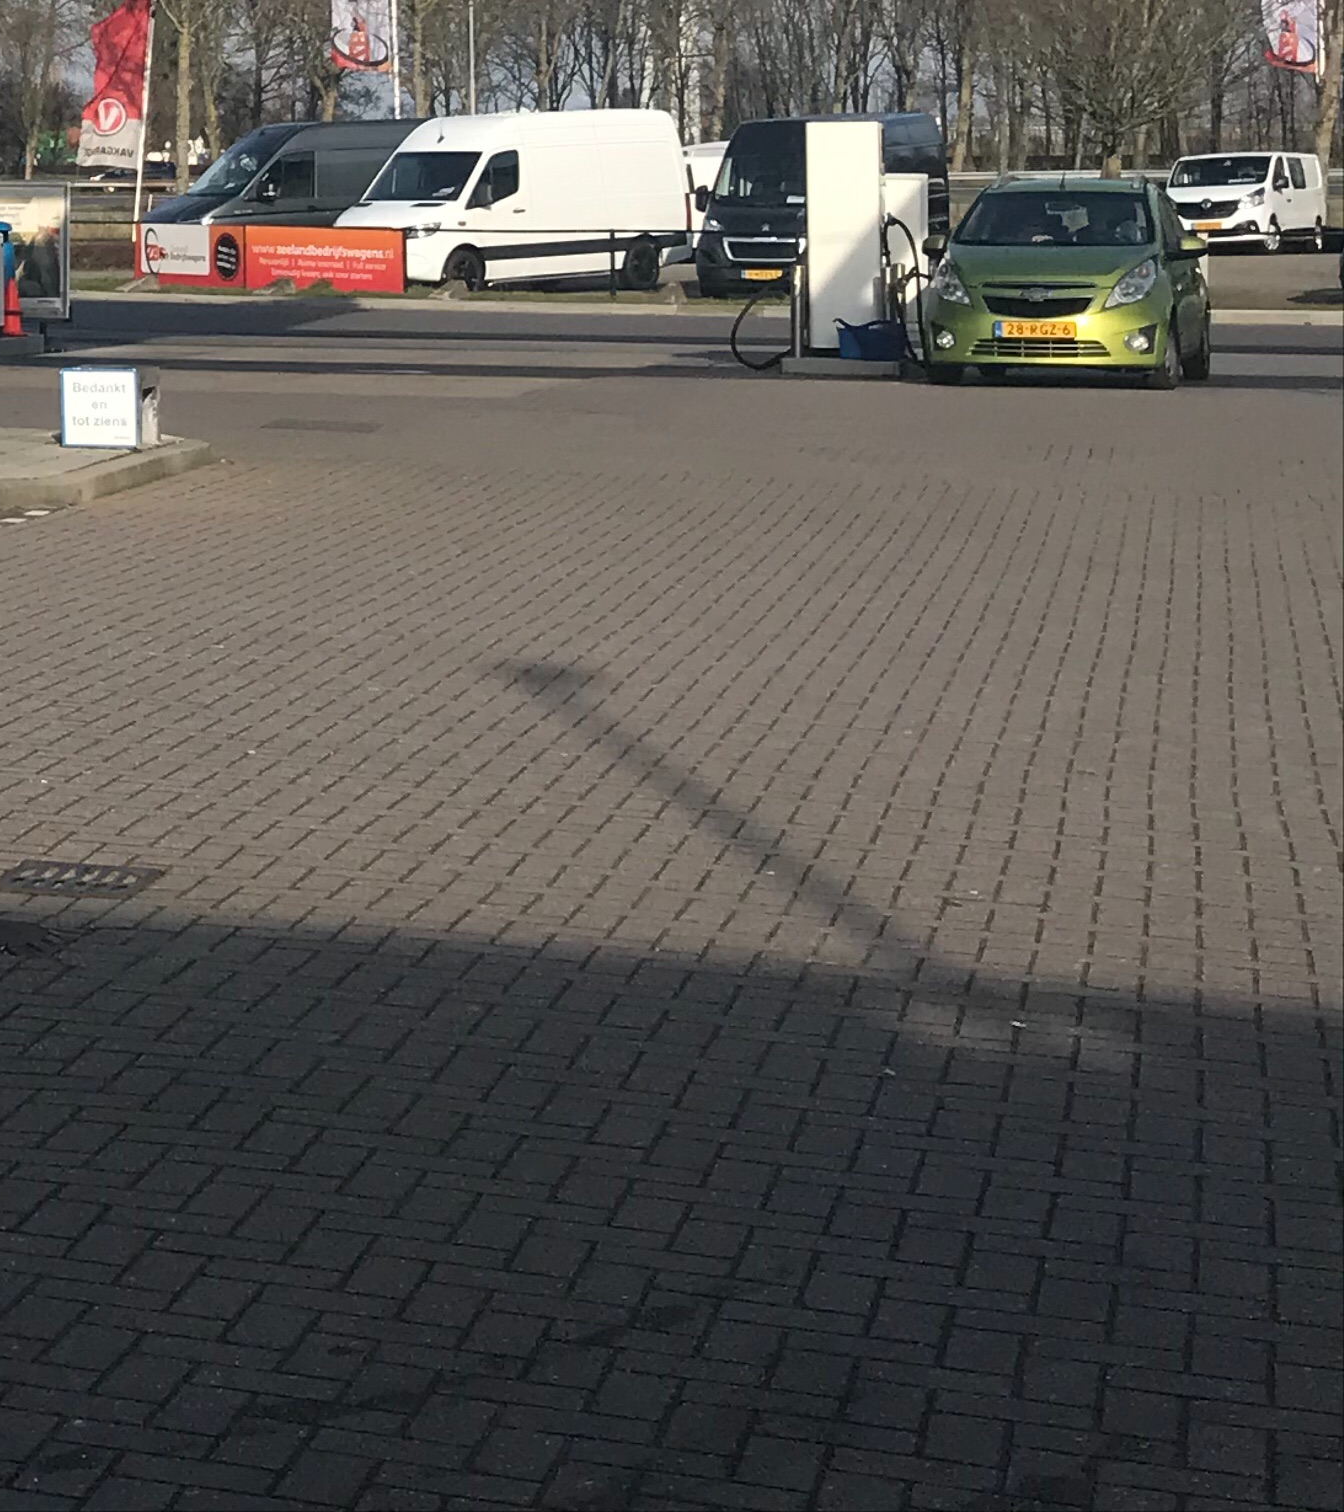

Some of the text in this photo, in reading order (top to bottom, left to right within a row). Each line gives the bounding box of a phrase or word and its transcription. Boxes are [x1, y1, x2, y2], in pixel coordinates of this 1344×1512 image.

[72, 382, 127, 394] Bedankt
[91, 401, 108, 410] en
[72, 416, 128, 427] tot ziens
